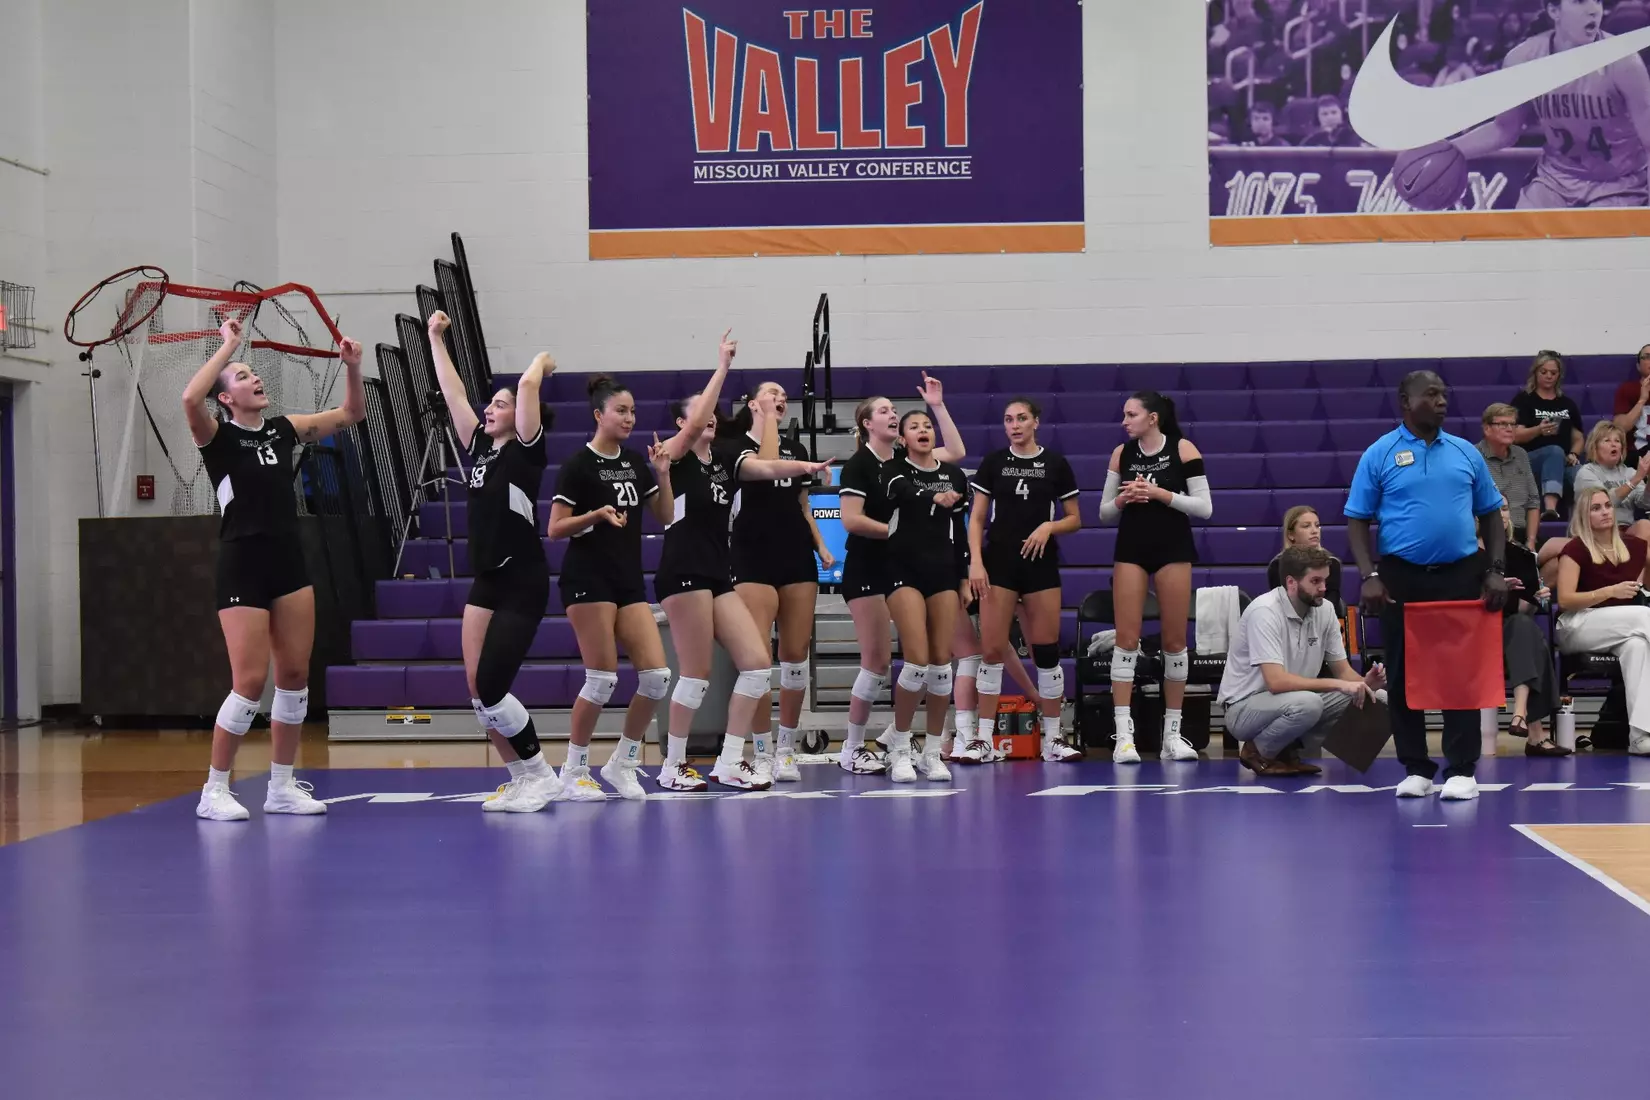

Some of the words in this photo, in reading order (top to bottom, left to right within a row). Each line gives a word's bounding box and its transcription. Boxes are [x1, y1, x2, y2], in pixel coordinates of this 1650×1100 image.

[783, 9, 873, 40] THE
[683, 0, 984, 153] VALLEY
[694, 164, 780, 180] MISSOURI
[788, 162, 849, 178] VALLEY
[855, 160, 972, 177] CONFERENCE
[257, 445, 278, 465] 13
[1001, 467, 1046, 478] SALUKIS
[612, 481, 639, 507] 20
[1015, 478, 1030, 500] 4
[813, 509, 842, 519] POWE
[998, 738, 1013, 754] G
